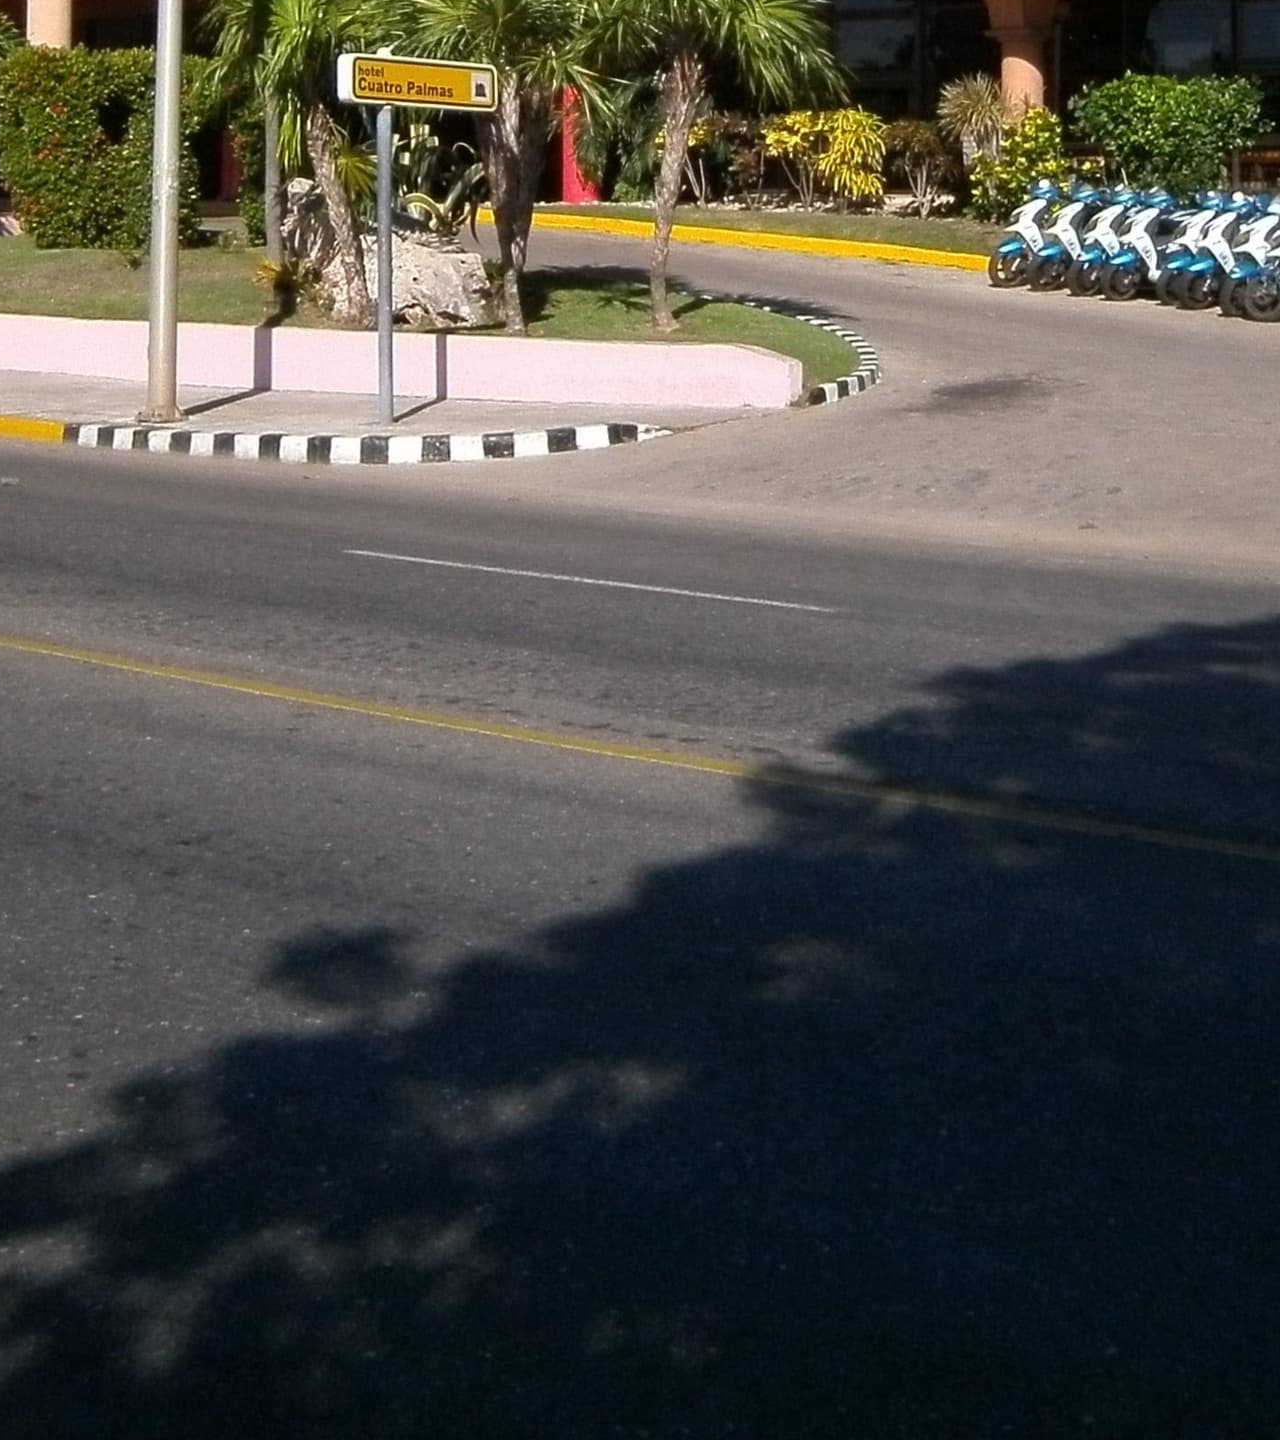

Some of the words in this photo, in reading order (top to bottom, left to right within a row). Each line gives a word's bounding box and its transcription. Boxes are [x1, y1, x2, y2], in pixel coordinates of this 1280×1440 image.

[358, 66, 385, 78] hotel
[358, 77, 403, 95] Cuatro
[406, 81, 454, 98] Palmas
